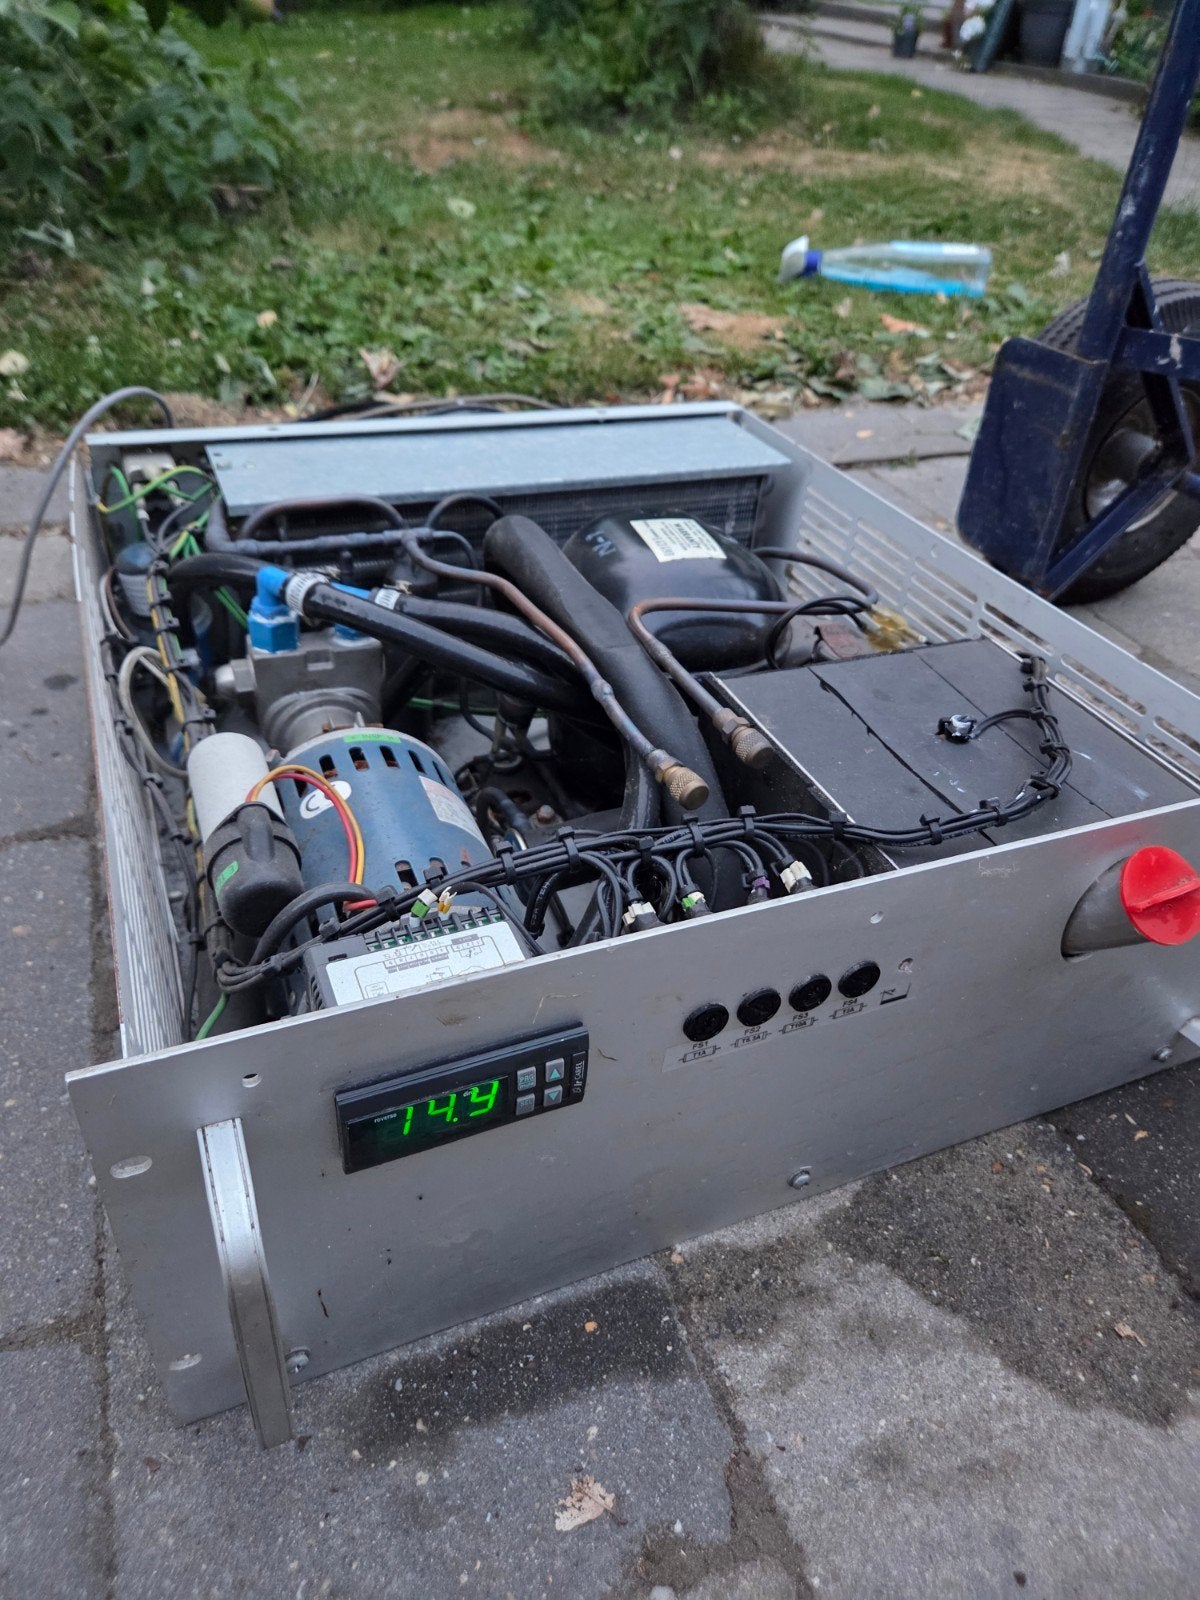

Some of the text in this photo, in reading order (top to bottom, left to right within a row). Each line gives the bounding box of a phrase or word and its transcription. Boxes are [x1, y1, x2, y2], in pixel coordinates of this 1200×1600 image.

[792, 1012, 809, 1022] FS3
[744, 1026, 761, 1036] FS2
[692, 1041, 709, 1050] FS1
[402, 1080, 499, 1136] 14.9
